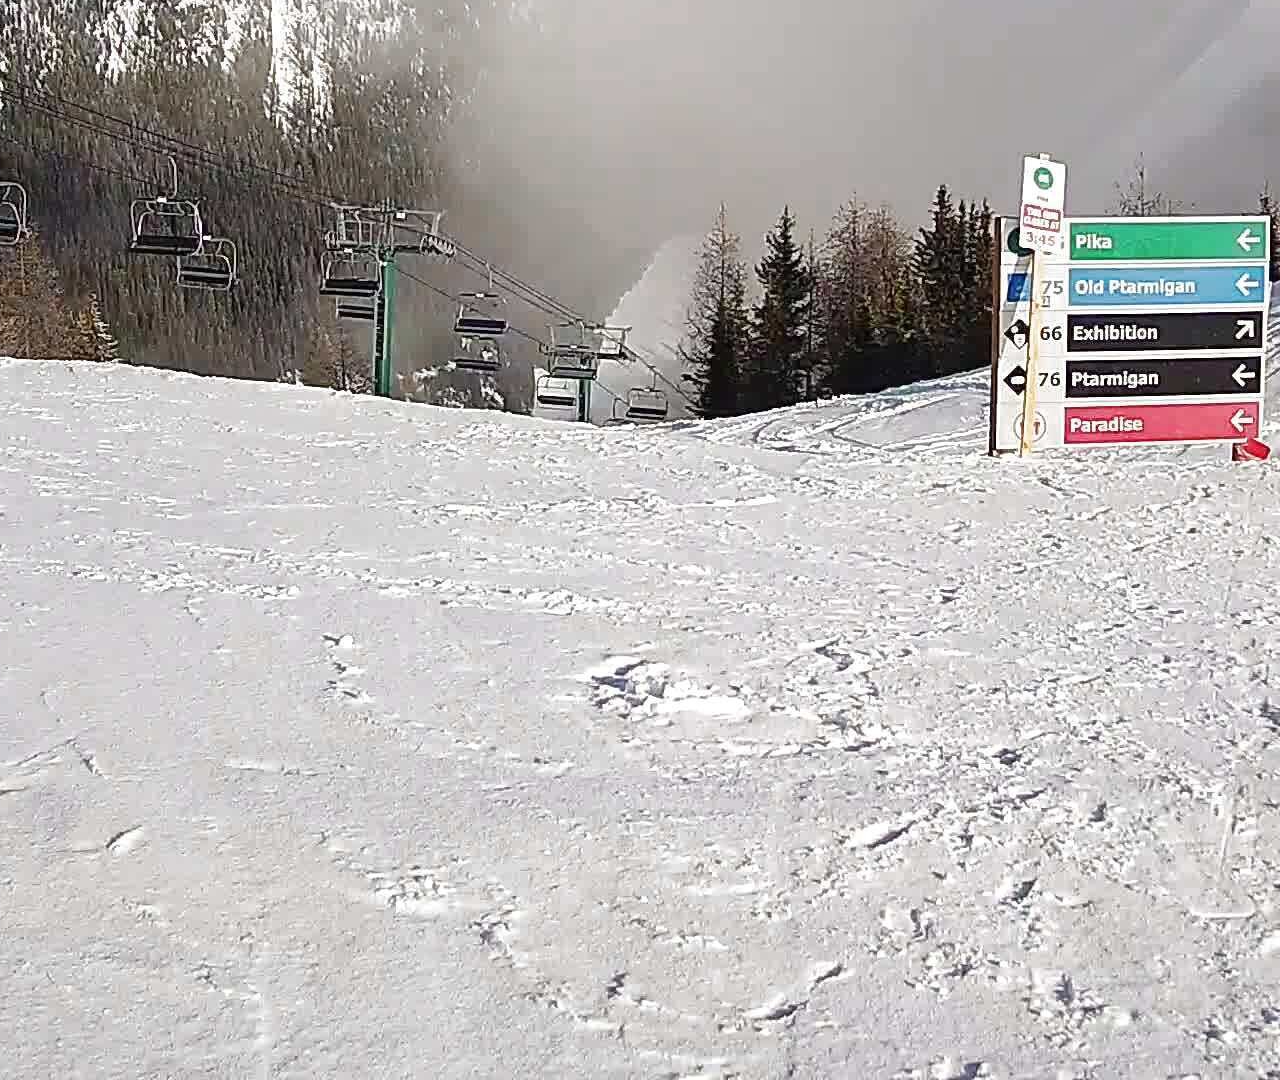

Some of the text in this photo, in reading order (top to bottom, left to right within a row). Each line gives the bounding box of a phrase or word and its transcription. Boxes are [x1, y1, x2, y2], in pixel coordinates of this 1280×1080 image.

[1026, 231, 1056, 247] 3:45
[1075, 233, 1113, 249] Pika
[1040, 278, 1196, 297] 75 Old Ptarmigan
[1039, 324, 1158, 341] 66 Exhibition
[1038, 370, 1160, 389] 76 Ptarmigan
[1069, 416, 1144, 433] Paradise
